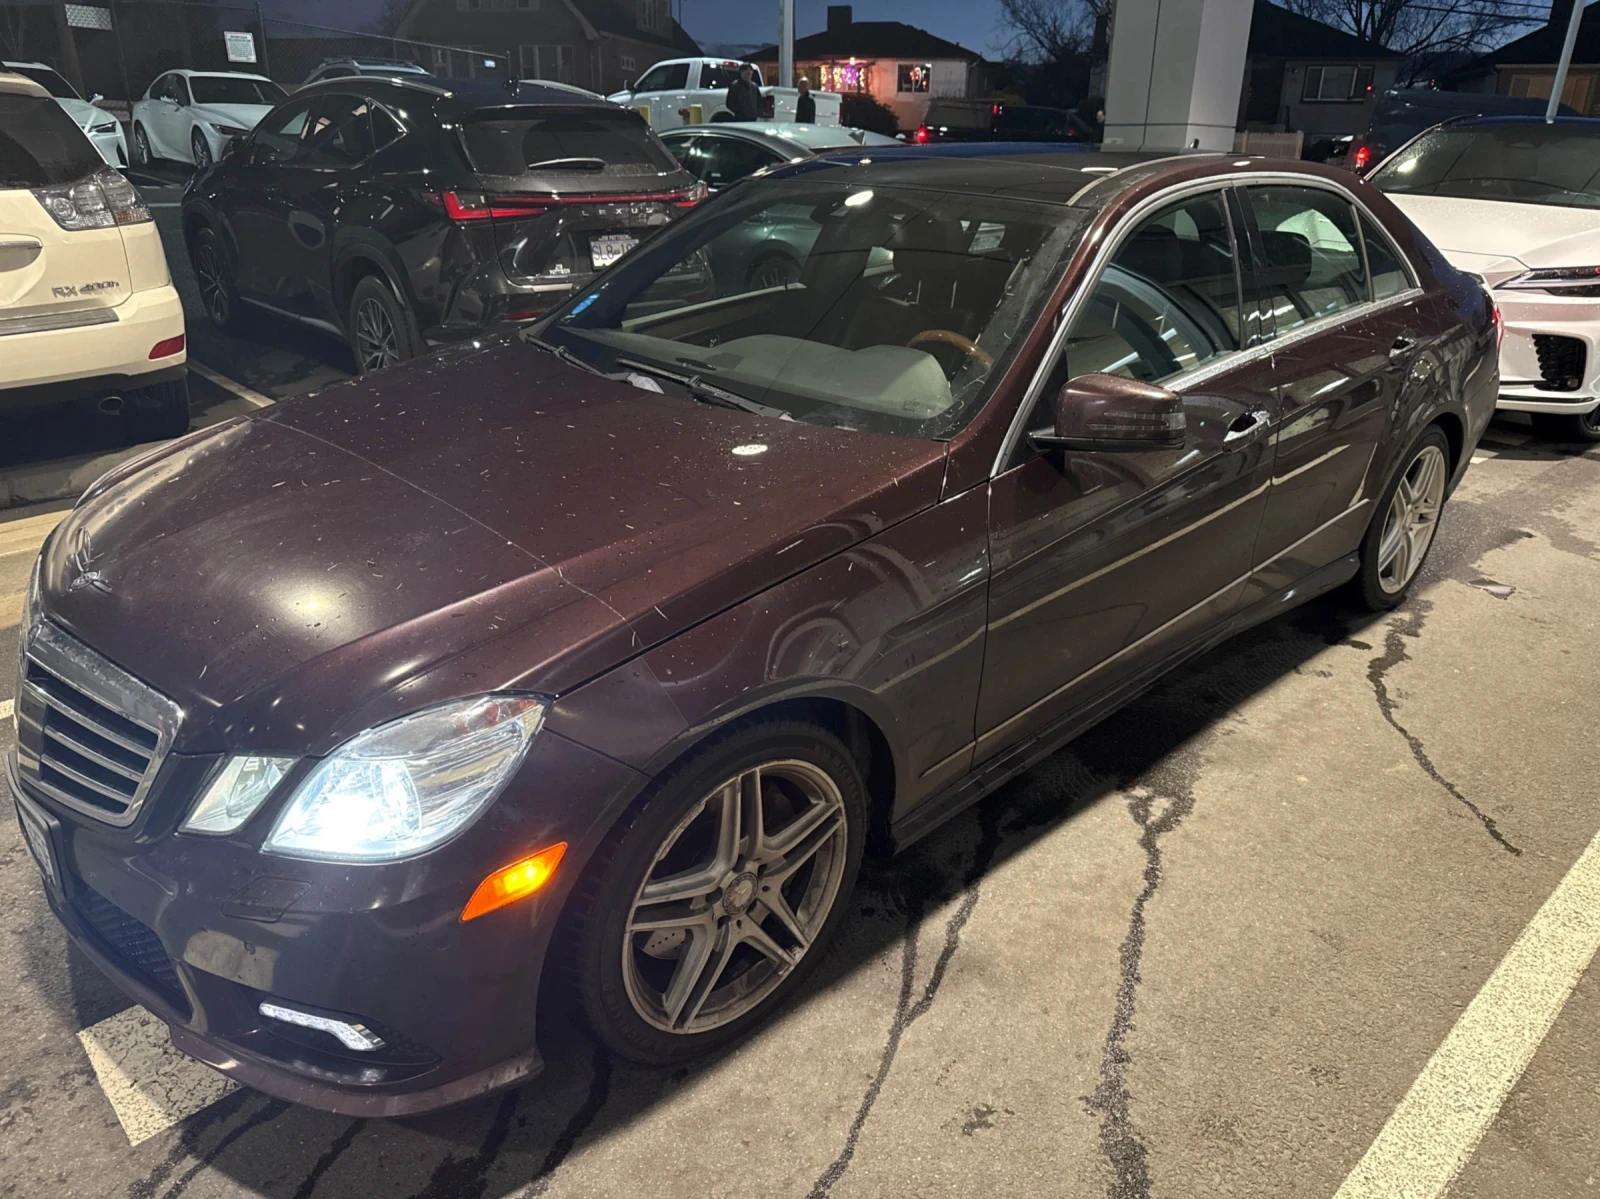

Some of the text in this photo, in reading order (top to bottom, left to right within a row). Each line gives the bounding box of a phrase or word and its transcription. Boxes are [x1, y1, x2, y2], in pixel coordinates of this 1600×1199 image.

[581, 207, 654, 216] LEXUS
[51, 280, 120, 298] RX 400h
